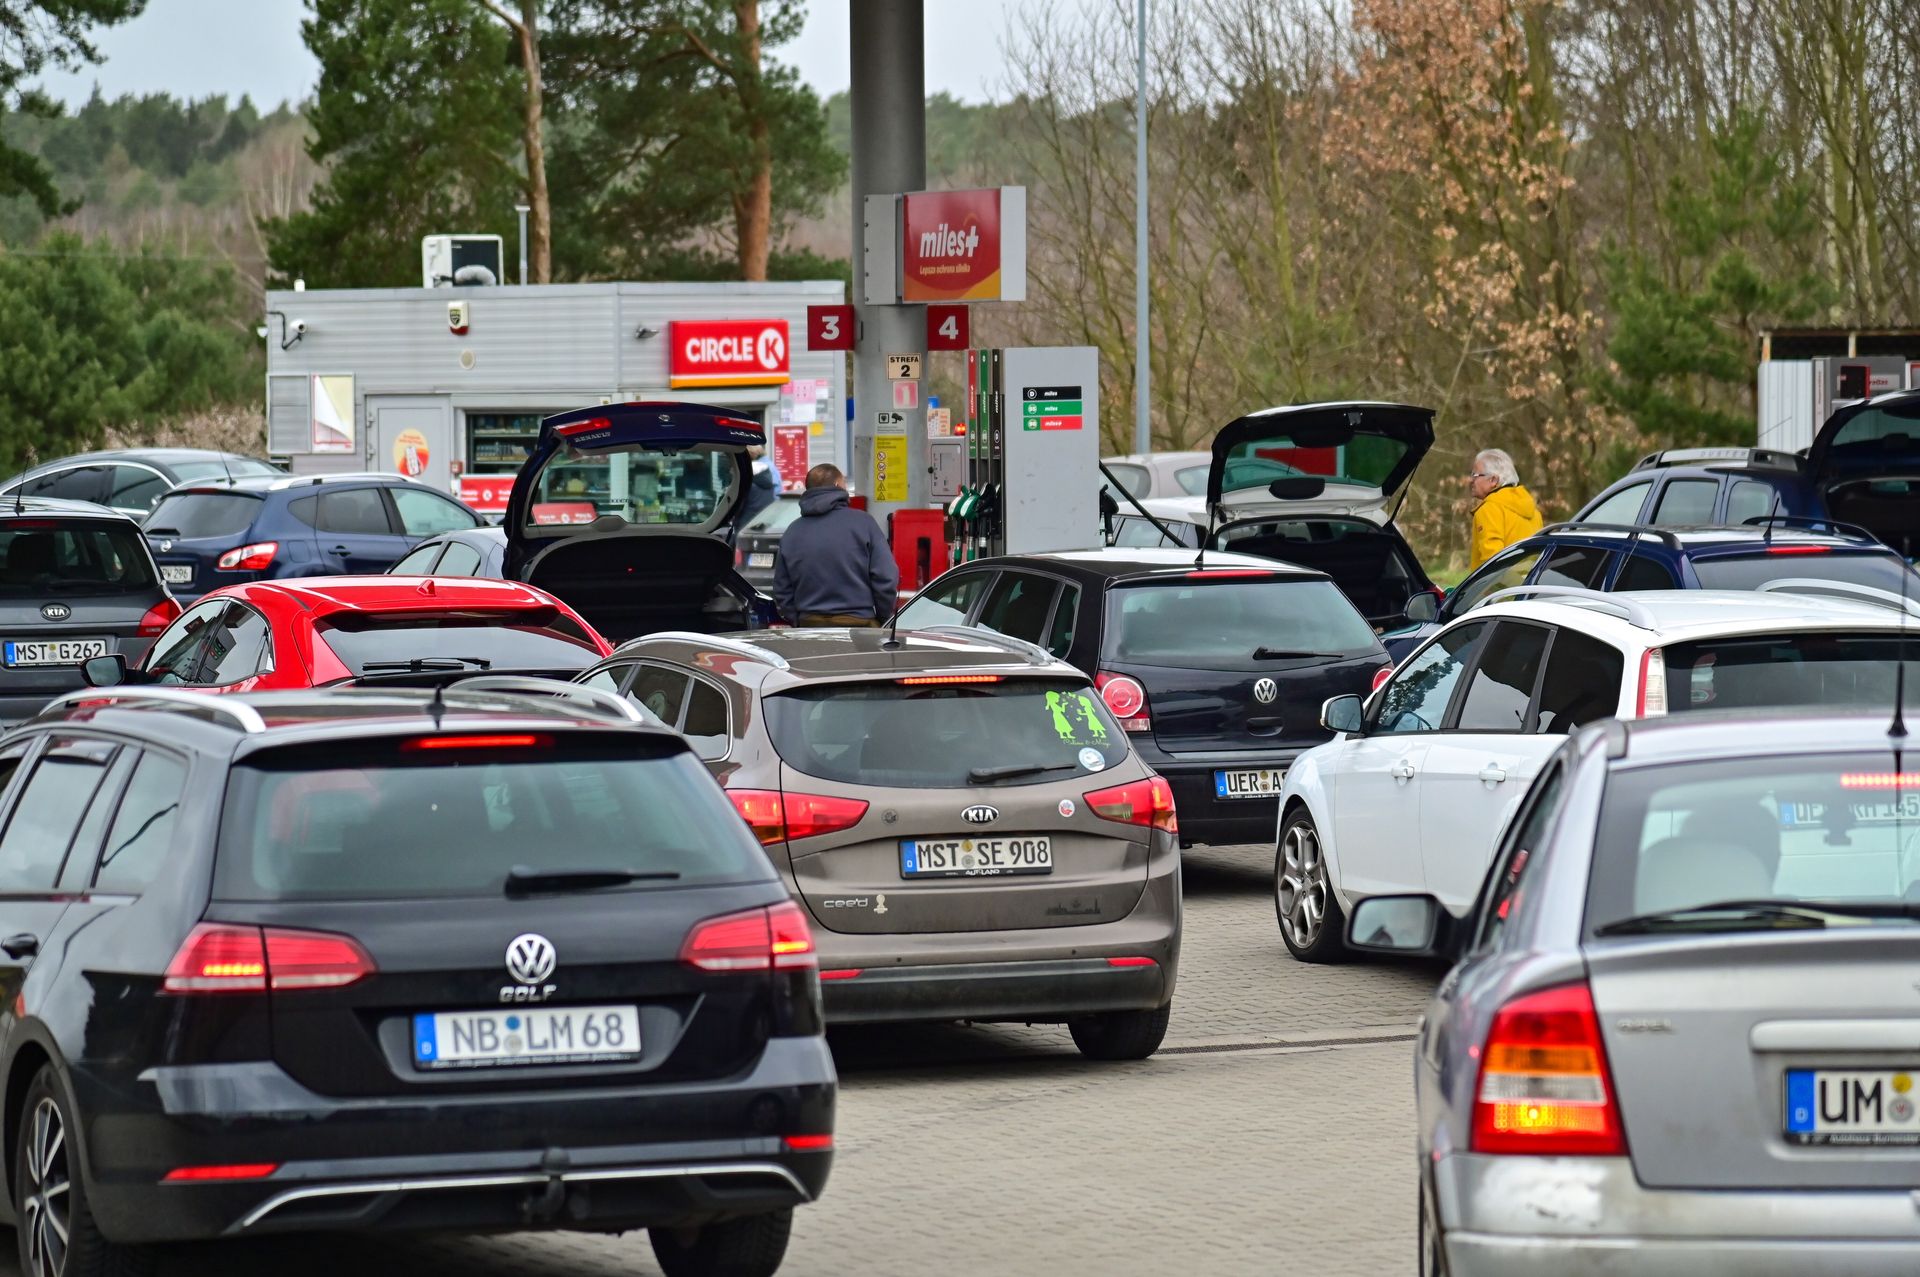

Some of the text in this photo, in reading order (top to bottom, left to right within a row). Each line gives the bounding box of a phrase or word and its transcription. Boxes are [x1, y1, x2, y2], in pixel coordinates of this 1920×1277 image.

[919, 223, 979, 258] miles+
[820, 315, 840, 340] 3
[938, 315, 959, 340] 4
[686, 334, 784, 368] CIRCLE K
[900, 364, 911, 377] 2
[47, 608, 66, 617] KIA
[16, 644, 48, 661] MST
[59, 643, 70, 659] G
[72, 642, 102, 660] 262
[1227, 772, 1260, 792] UER
[968, 809, 994, 821] KIA
[917, 843, 959, 868] MST
[977, 841, 1004, 866] SE
[1009, 840, 1049, 865] 908
[823, 897, 868, 908] cee'd
[500, 985, 557, 1003] GOLF
[451, 1016, 499, 1054] NB
[526, 1014, 574, 1051] LM
[582, 1012, 625, 1049] 68
[1795, 1078, 1882, 1124] D UM
